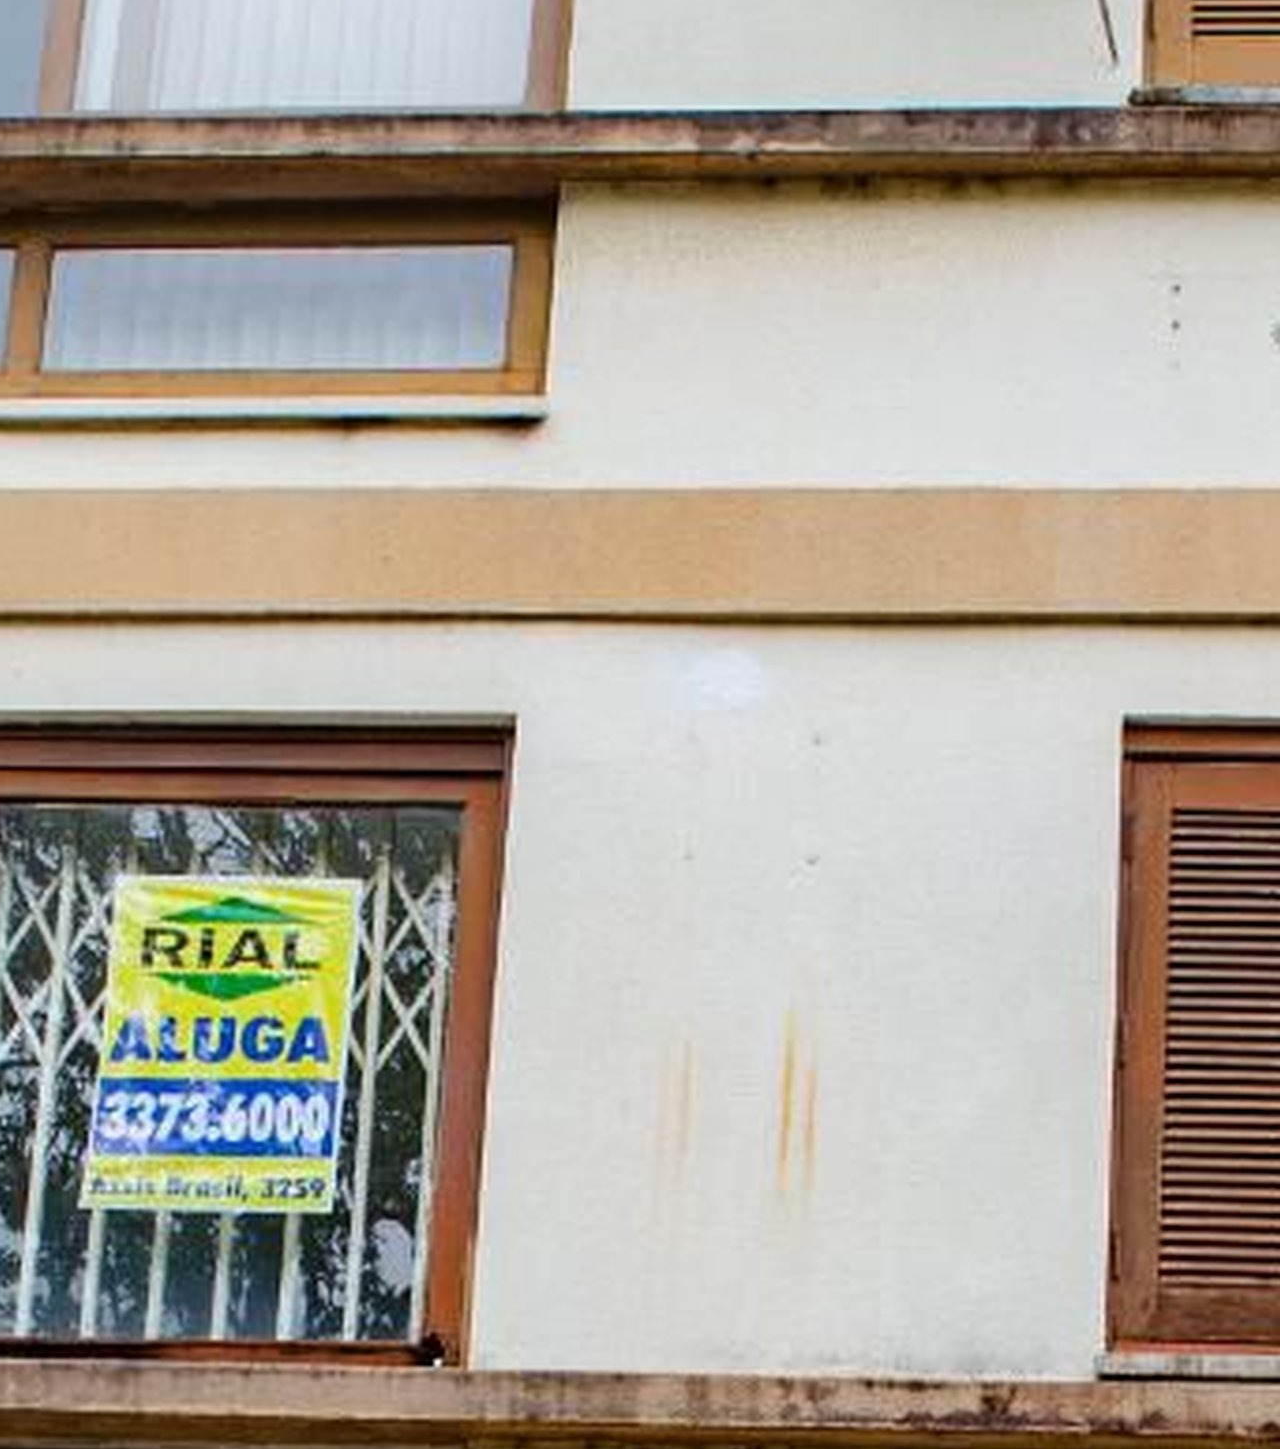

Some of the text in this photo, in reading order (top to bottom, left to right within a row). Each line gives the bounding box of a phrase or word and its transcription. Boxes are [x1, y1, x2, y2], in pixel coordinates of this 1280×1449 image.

[141, 928, 322, 969] RIAL
[109, 1016, 330, 1063] ALUGA
[97, 1091, 330, 1143] 3373.6000
[260, 1177, 326, 1199] 3259
